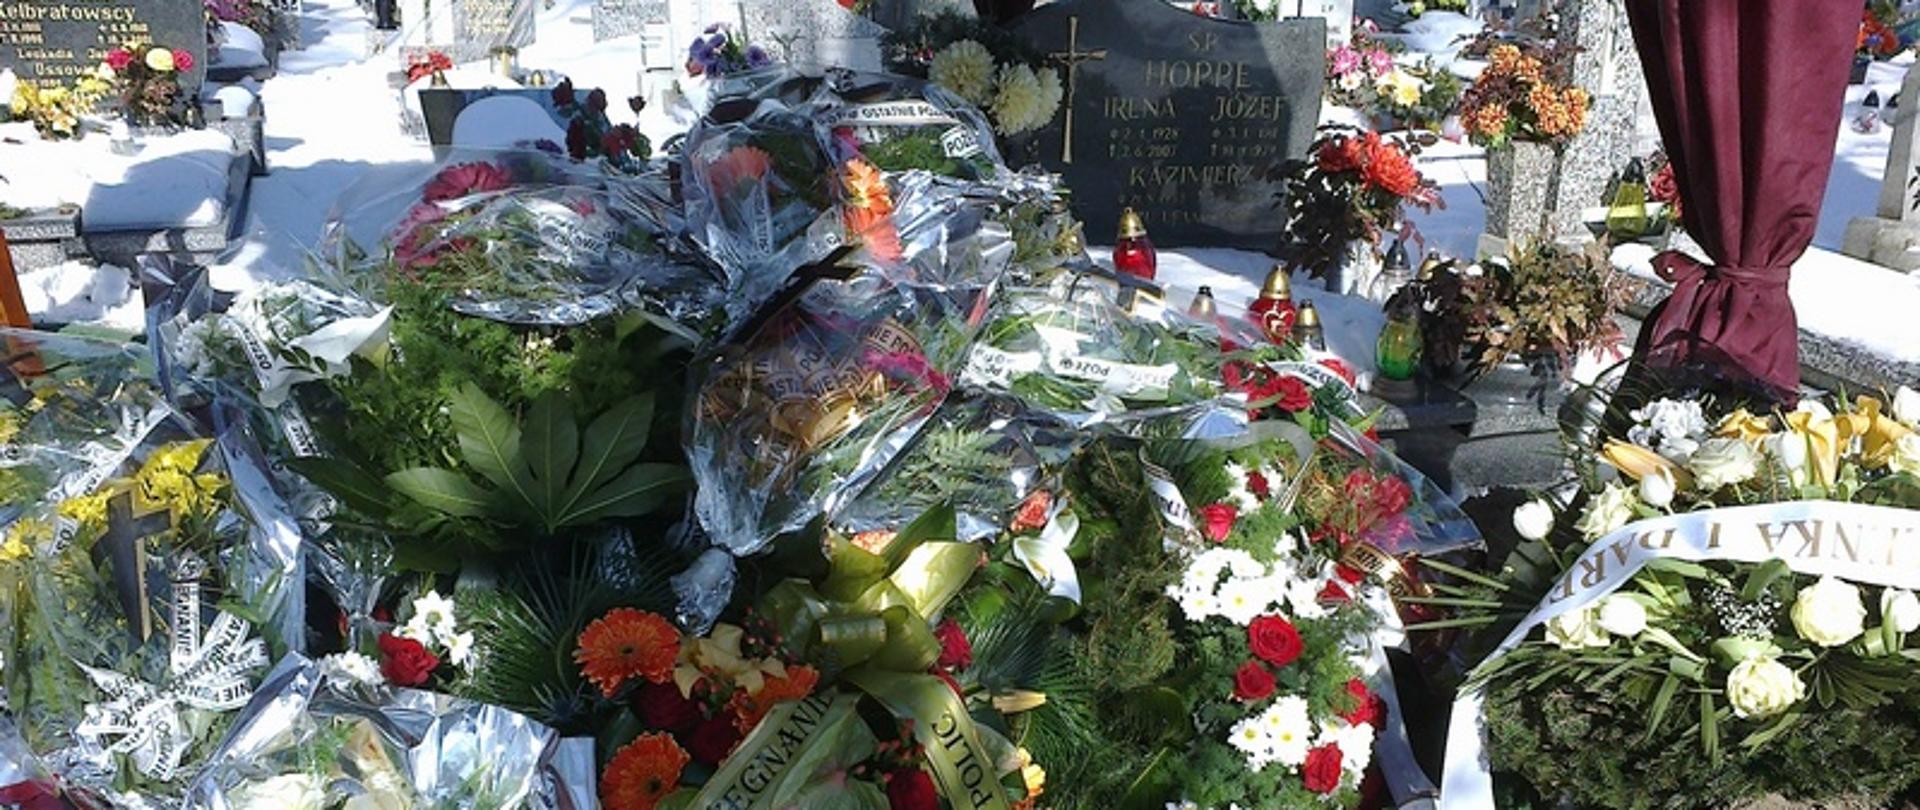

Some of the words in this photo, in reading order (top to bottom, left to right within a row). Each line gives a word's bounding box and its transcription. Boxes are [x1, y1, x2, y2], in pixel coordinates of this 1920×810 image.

[1146, 60, 1251, 88] HOPPE
[1104, 97, 1176, 120] IRENA
[1131, 165, 1256, 187] KAZIMIERZ
[931, 714, 993, 809] POLIC
